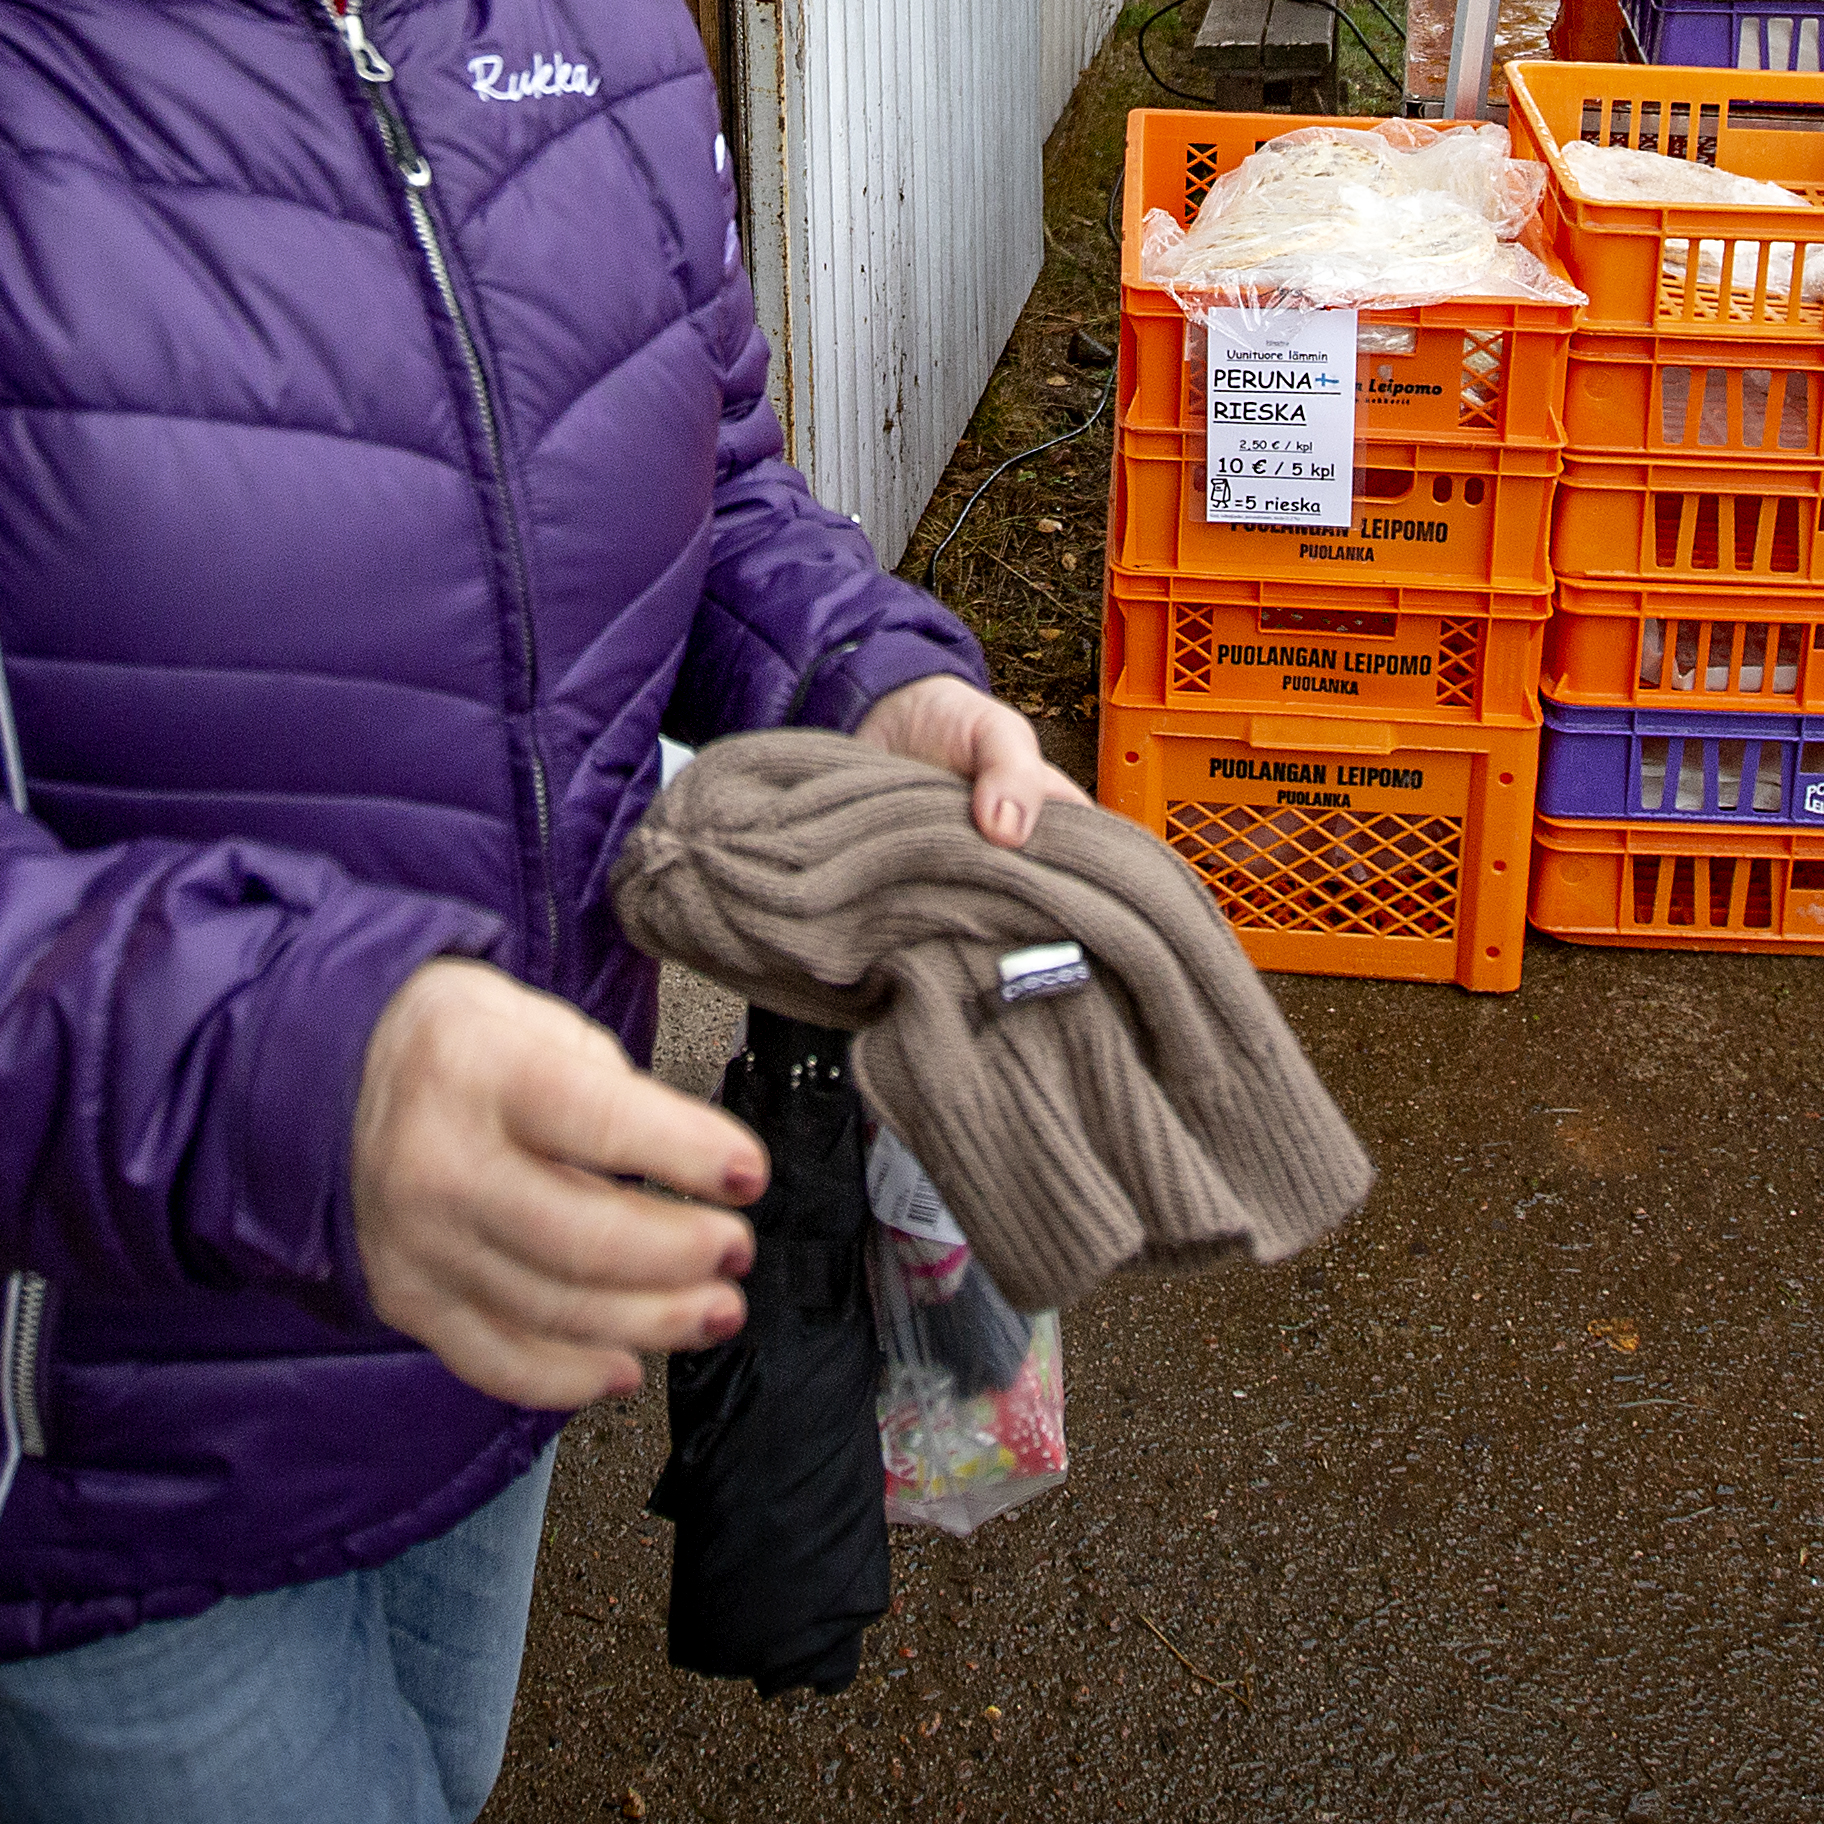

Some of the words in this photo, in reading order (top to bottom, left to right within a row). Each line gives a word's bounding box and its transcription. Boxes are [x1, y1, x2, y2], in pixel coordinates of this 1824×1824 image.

[467, 51, 603, 102] Rukka
[1226, 349, 1283, 361] Uunituore
[1288, 349, 1328, 361] lämmin
[1213, 368, 1313, 390] PERUNA
[1369, 378, 1443, 397] Leipomo
[1213, 400, 1307, 422] RIESKA
[1272, 440, 1281, 450] €
[1285, 440, 1291, 450] /
[1295, 440, 1313, 453] kpl
[1218, 457, 1243, 474] 10
[1252, 459, 1267, 475] €
[1274, 461, 1284, 475] /
[1292, 462, 1303, 476] 5
[1311, 462, 1335, 480] kpl
[1265, 496, 1321, 513] rieska
[1361, 517, 1449, 543] LEIPOMO
[1299, 543, 1375, 563] PUOLANKA
[1217, 644, 1337, 669] PUOLANGAN
[1344, 651, 1432, 676] LEIPOMO
[1282, 675, 1359, 695] PUOLANKA
[1209, 757, 1327, 785] PUOLANGAN
[1337, 765, 1424, 790] LEIPOMO
[1277, 789, 1352, 808] PUOLANKA
